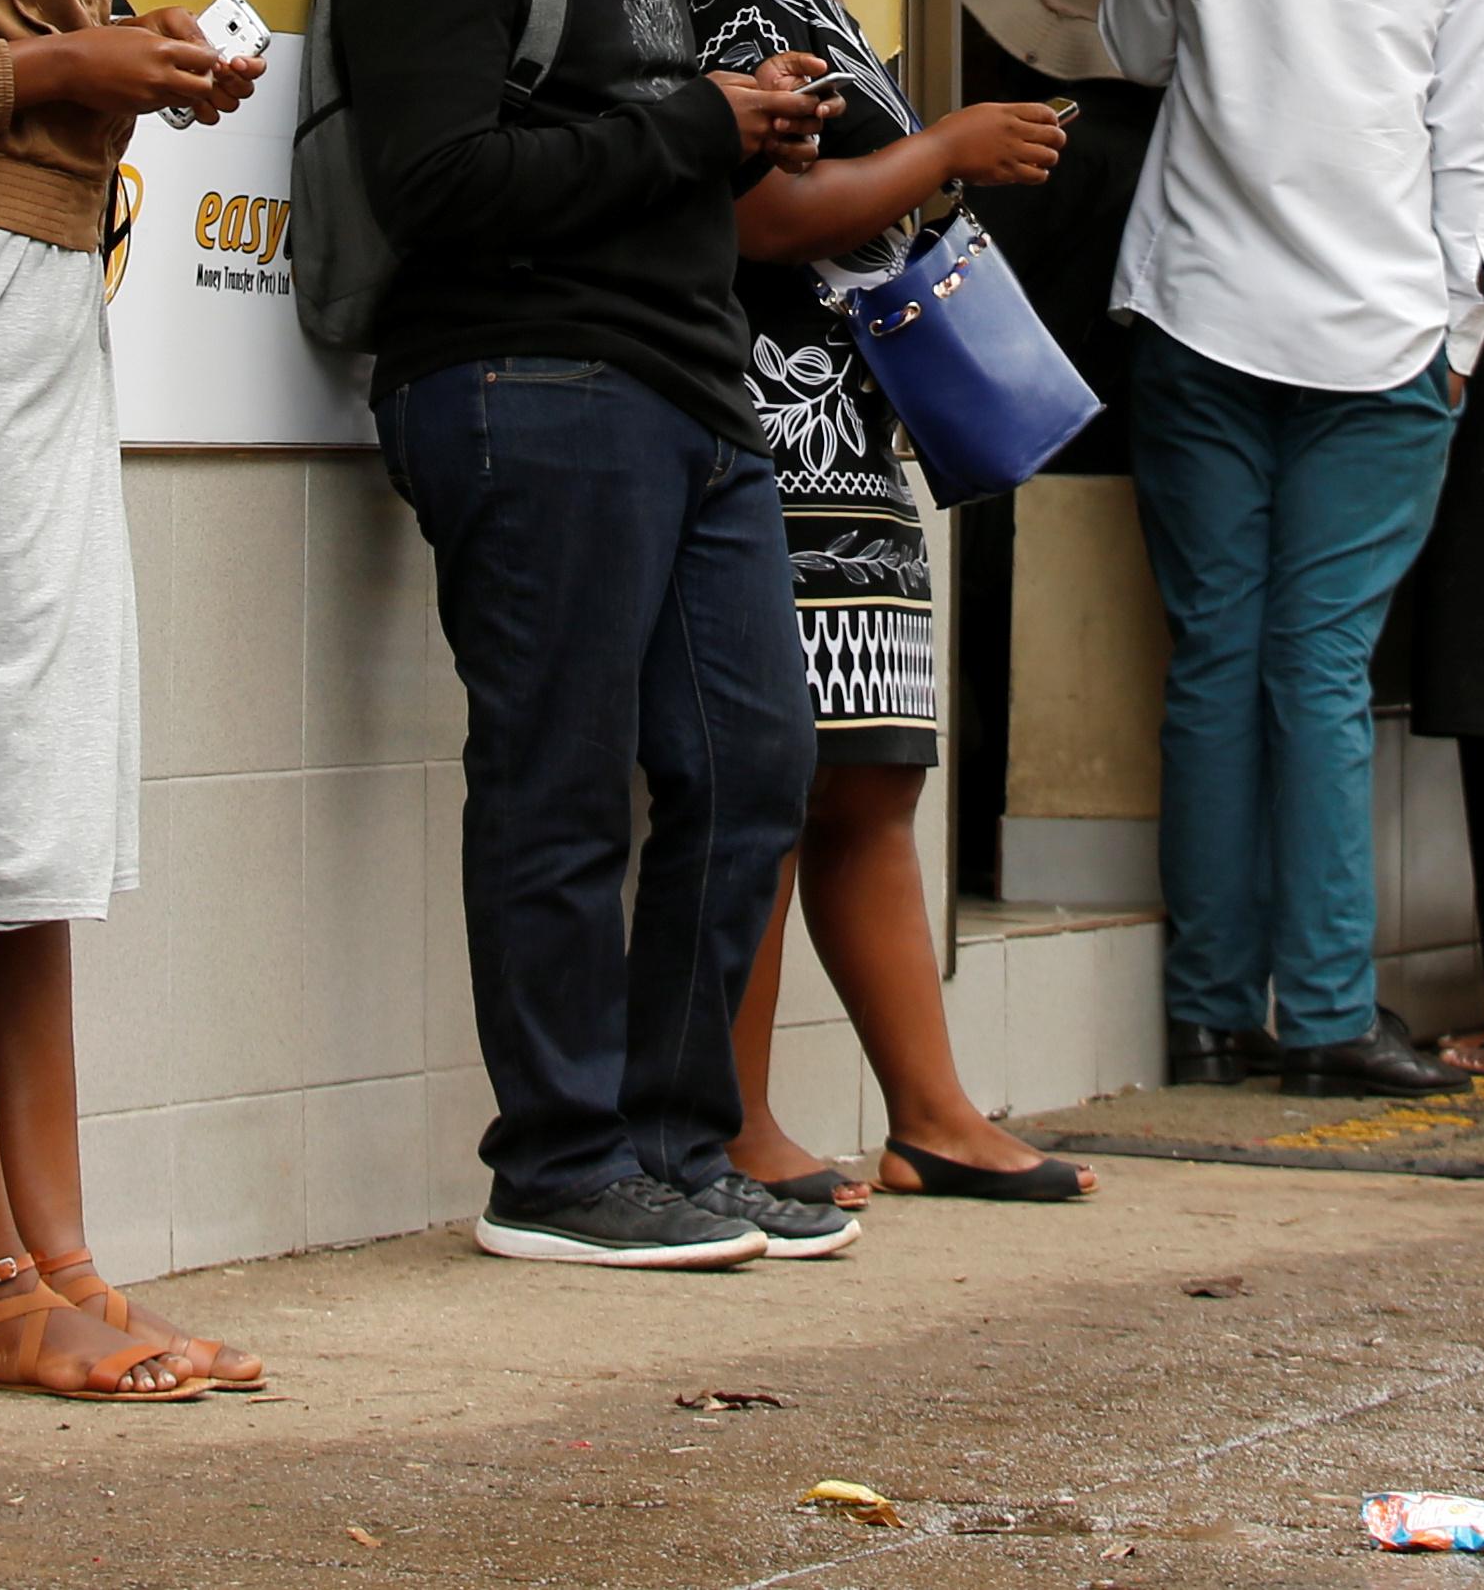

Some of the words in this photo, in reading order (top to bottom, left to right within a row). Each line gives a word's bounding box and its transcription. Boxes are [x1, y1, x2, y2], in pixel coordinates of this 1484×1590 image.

[195, 191, 293, 266] easy
[196, 263, 222, 292] Money
[224, 266, 255, 294] Transfer
[257, 269, 276, 296] (Pvt)
[278, 271, 291, 295] Ltd
